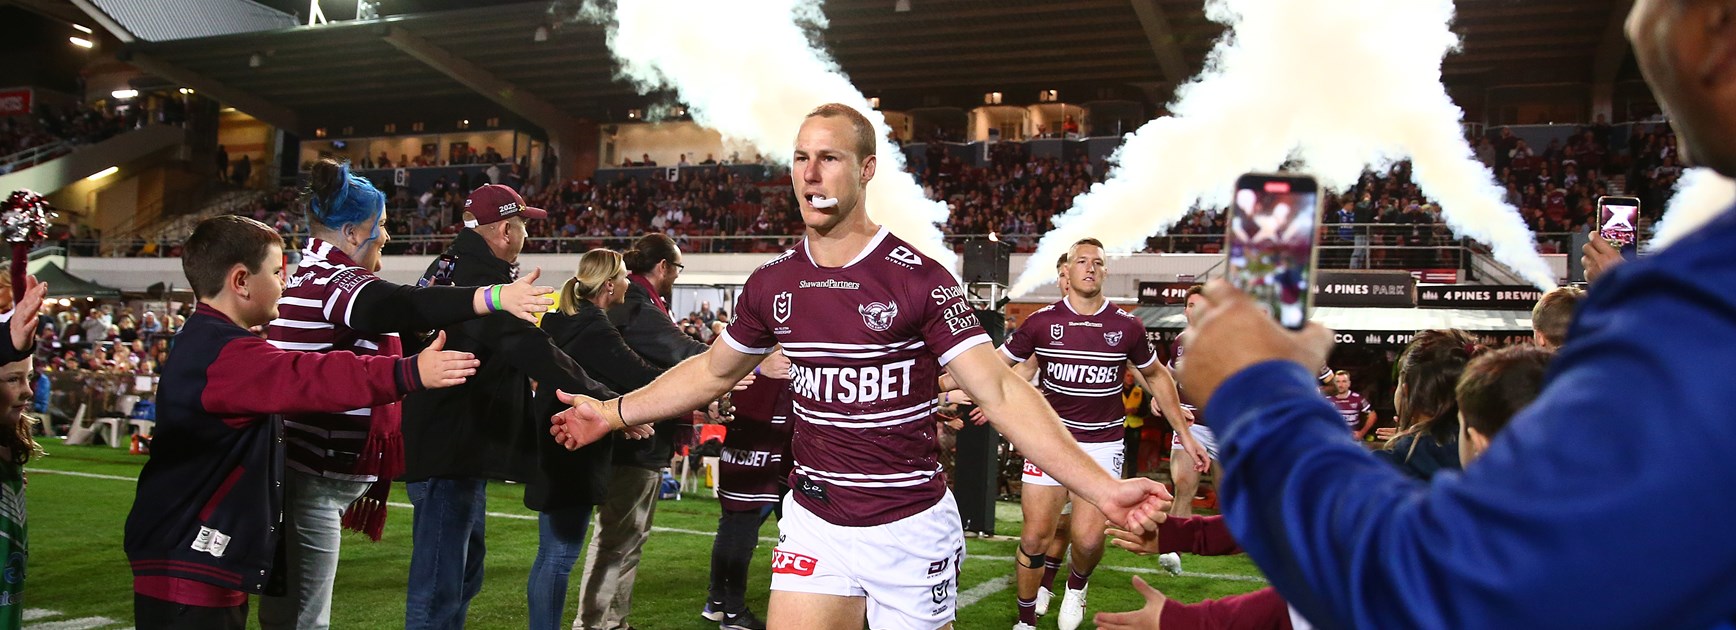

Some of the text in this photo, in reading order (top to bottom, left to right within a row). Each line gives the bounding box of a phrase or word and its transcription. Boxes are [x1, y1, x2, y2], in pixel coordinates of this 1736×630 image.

[397, 170, 404, 183] G
[668, 168, 677, 180] F
[498, 202, 517, 213] 2023
[884, 256, 915, 271] DYNASTY
[1161, 288, 1170, 298] 4
[1324, 284, 1405, 295] 4 PINES PARK
[1443, 291, 1544, 301] 4 PINES BREWIN
[943, 298, 971, 320] and
[1334, 333, 1356, 344] CO.
[1386, 334, 1395, 344] 4
[1503, 335, 1534, 345] 4 PIN
[1046, 361, 1120, 384] POINTSBET
[789, 358, 916, 404] OINTSBET
